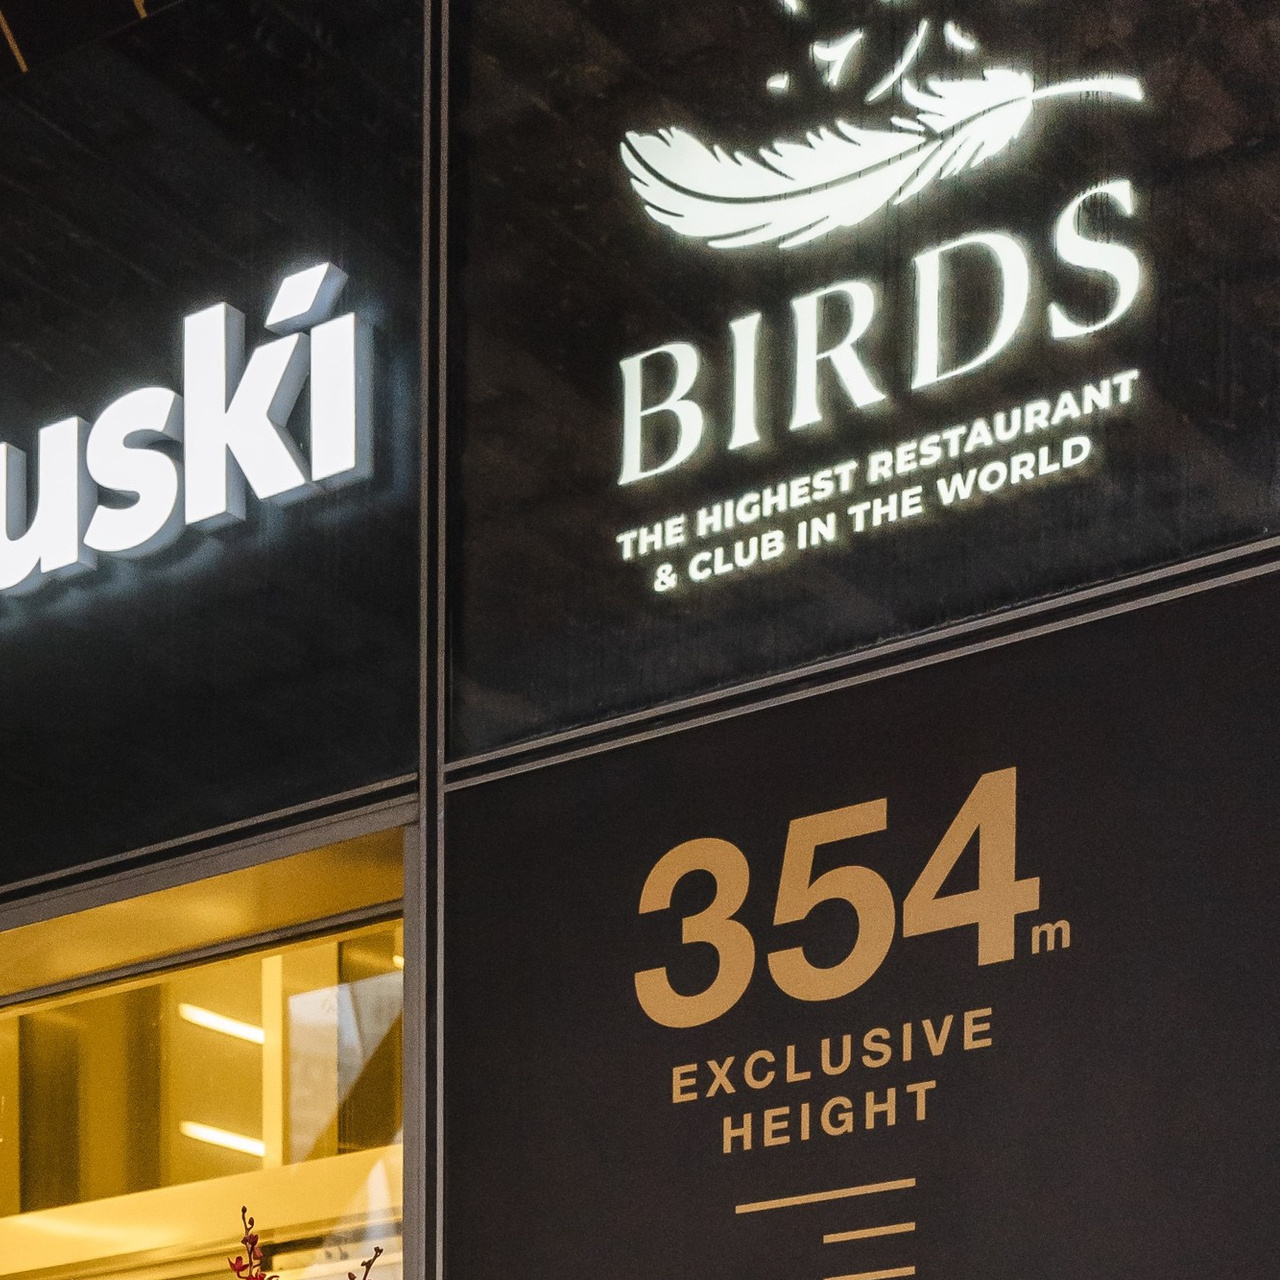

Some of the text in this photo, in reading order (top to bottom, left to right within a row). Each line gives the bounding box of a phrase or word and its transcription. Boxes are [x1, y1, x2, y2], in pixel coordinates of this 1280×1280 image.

[617, 177, 1141, 486] BIRDS
[616, 369, 1140, 561] THE HIGHEST RESTAURANT
[653, 435, 1093, 592] & CLUB IN THE WORLD
[634, 765, 1041, 1029] 354
[671, 1007, 993, 1104] EXCLUSIVE
[722, 1080, 937, 1155] HEIGHT
